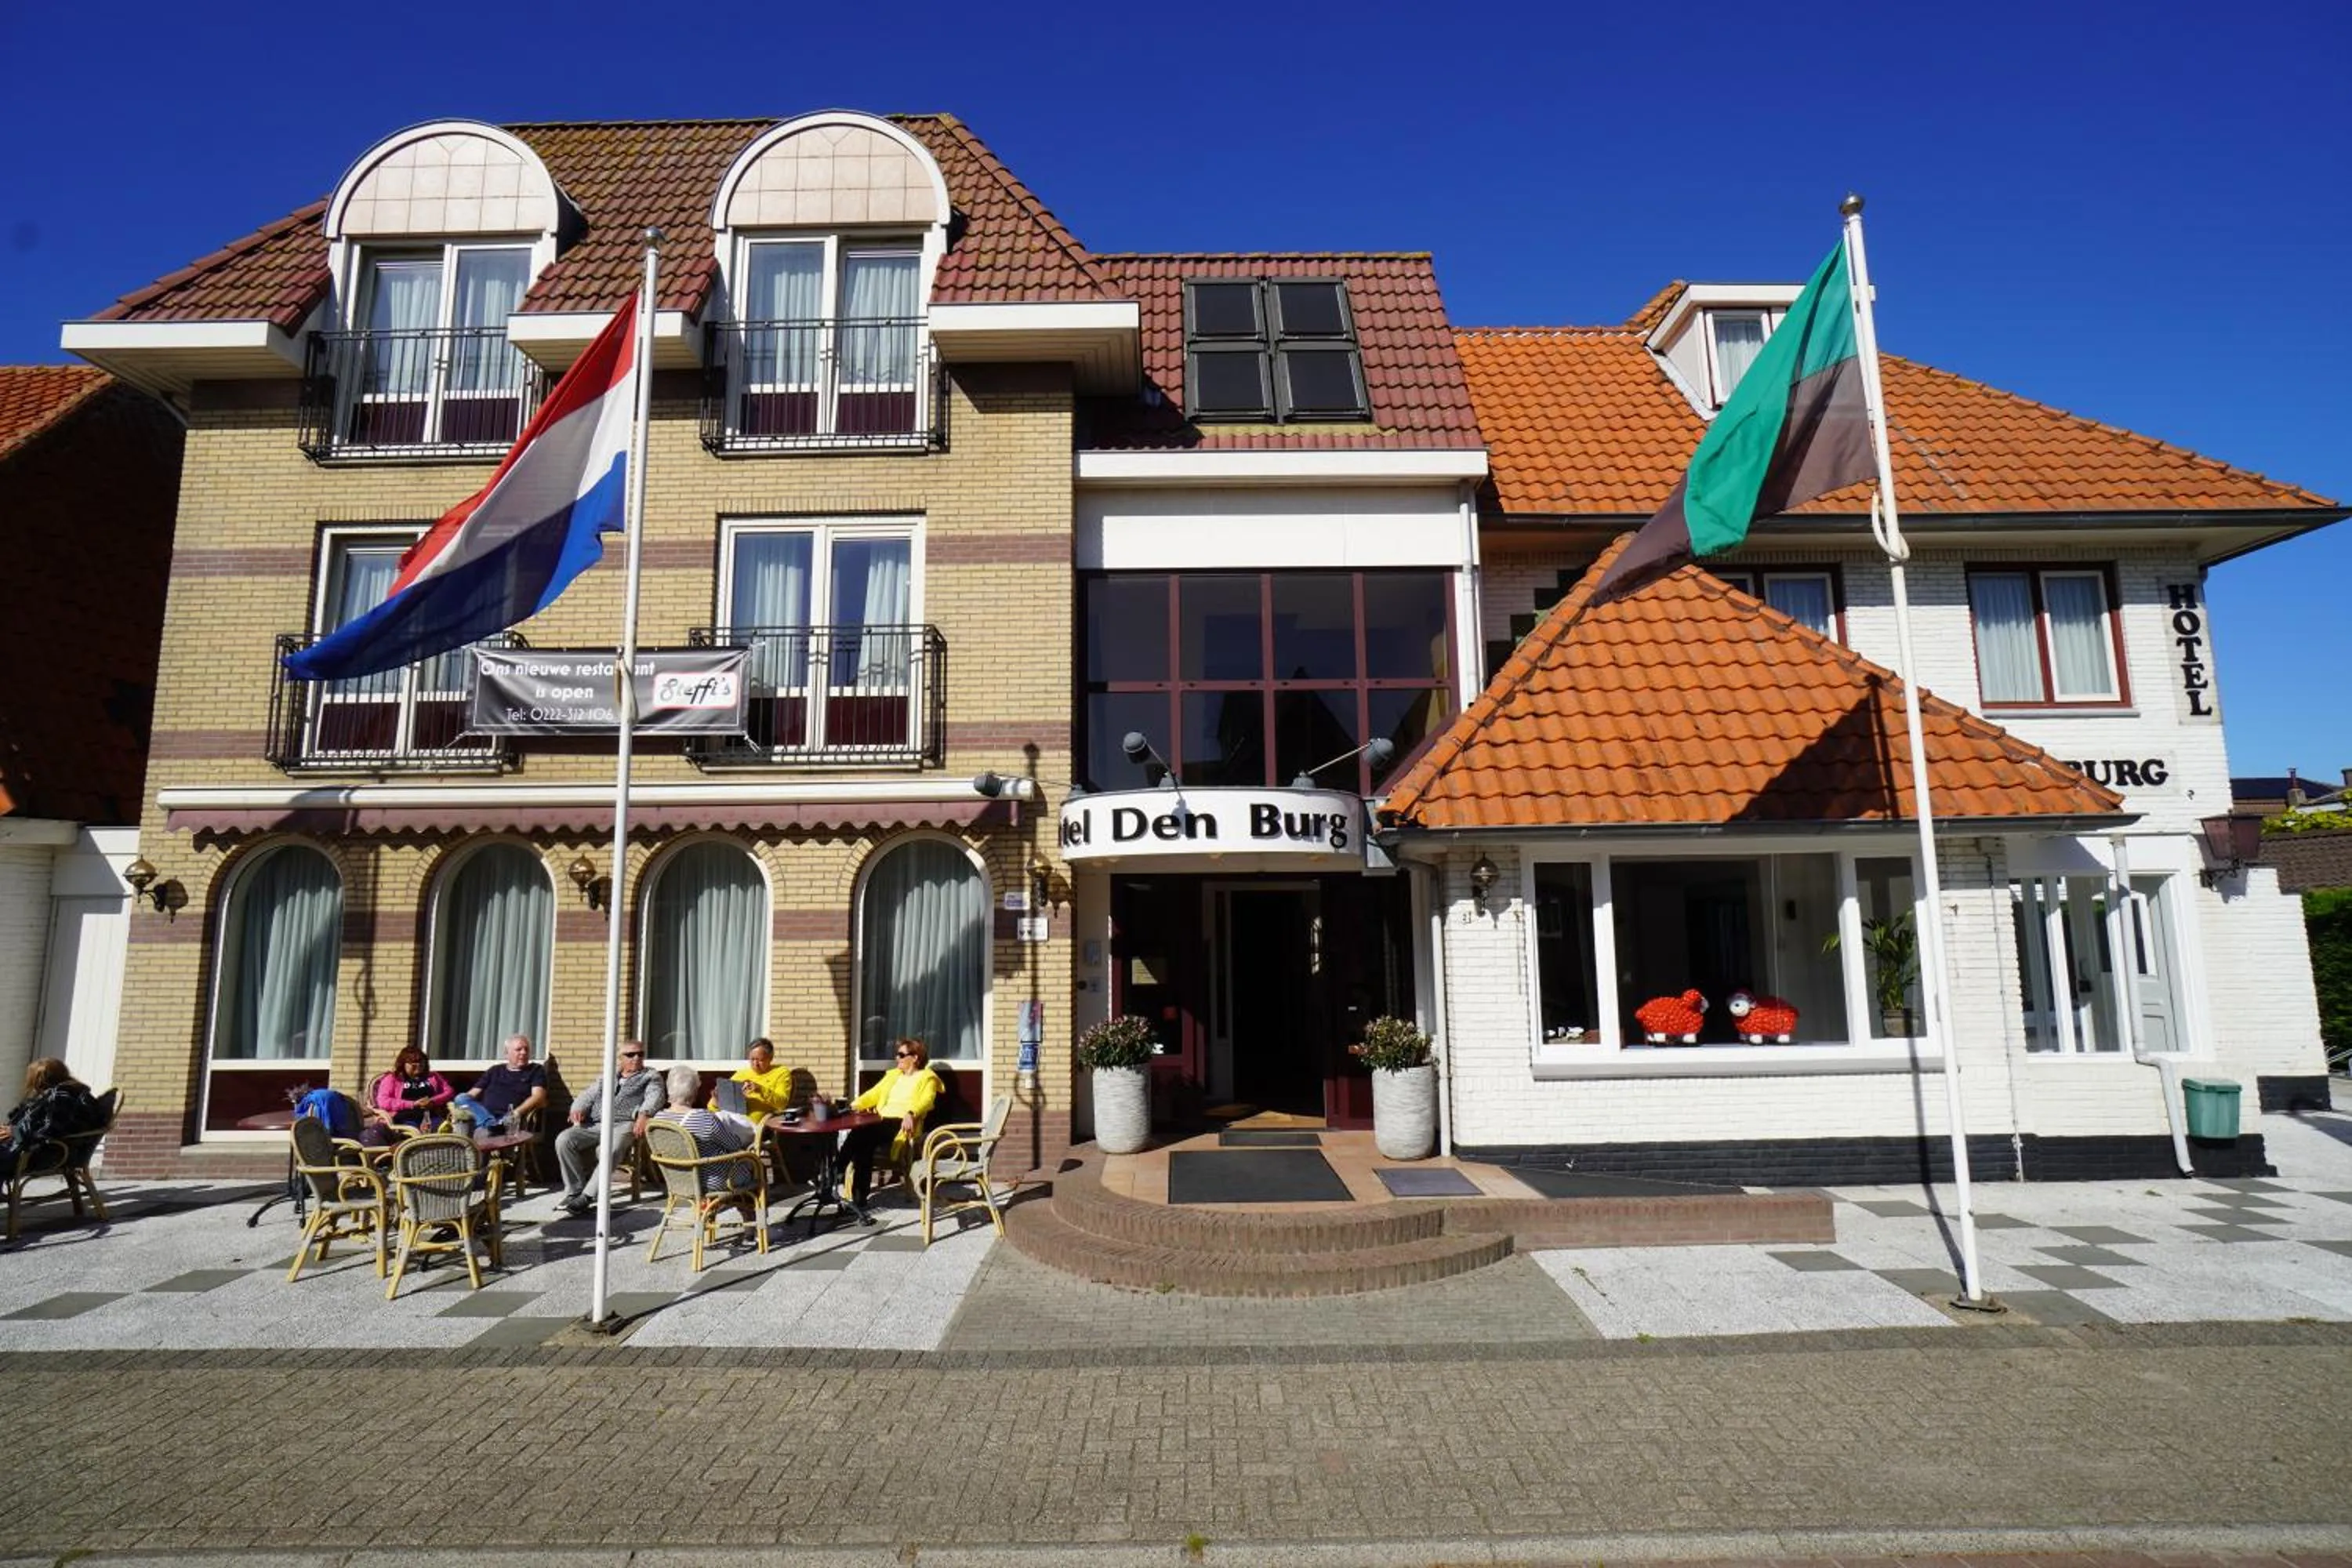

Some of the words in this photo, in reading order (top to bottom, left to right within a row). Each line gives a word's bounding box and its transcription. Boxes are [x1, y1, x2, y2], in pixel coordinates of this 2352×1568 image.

[2167, 584, 2212, 717] HOTEL
[481, 660, 510, 677] Ons
[515, 662, 571, 676] nieuwe
[576, 662, 655, 677] restant
[551, 687, 594, 702] open
[506, 708, 526, 720] Tel:
[1058, 808, 1091, 845] tel
[1112, 808, 1217, 842] Den
[1249, 803, 1348, 848] Burg
